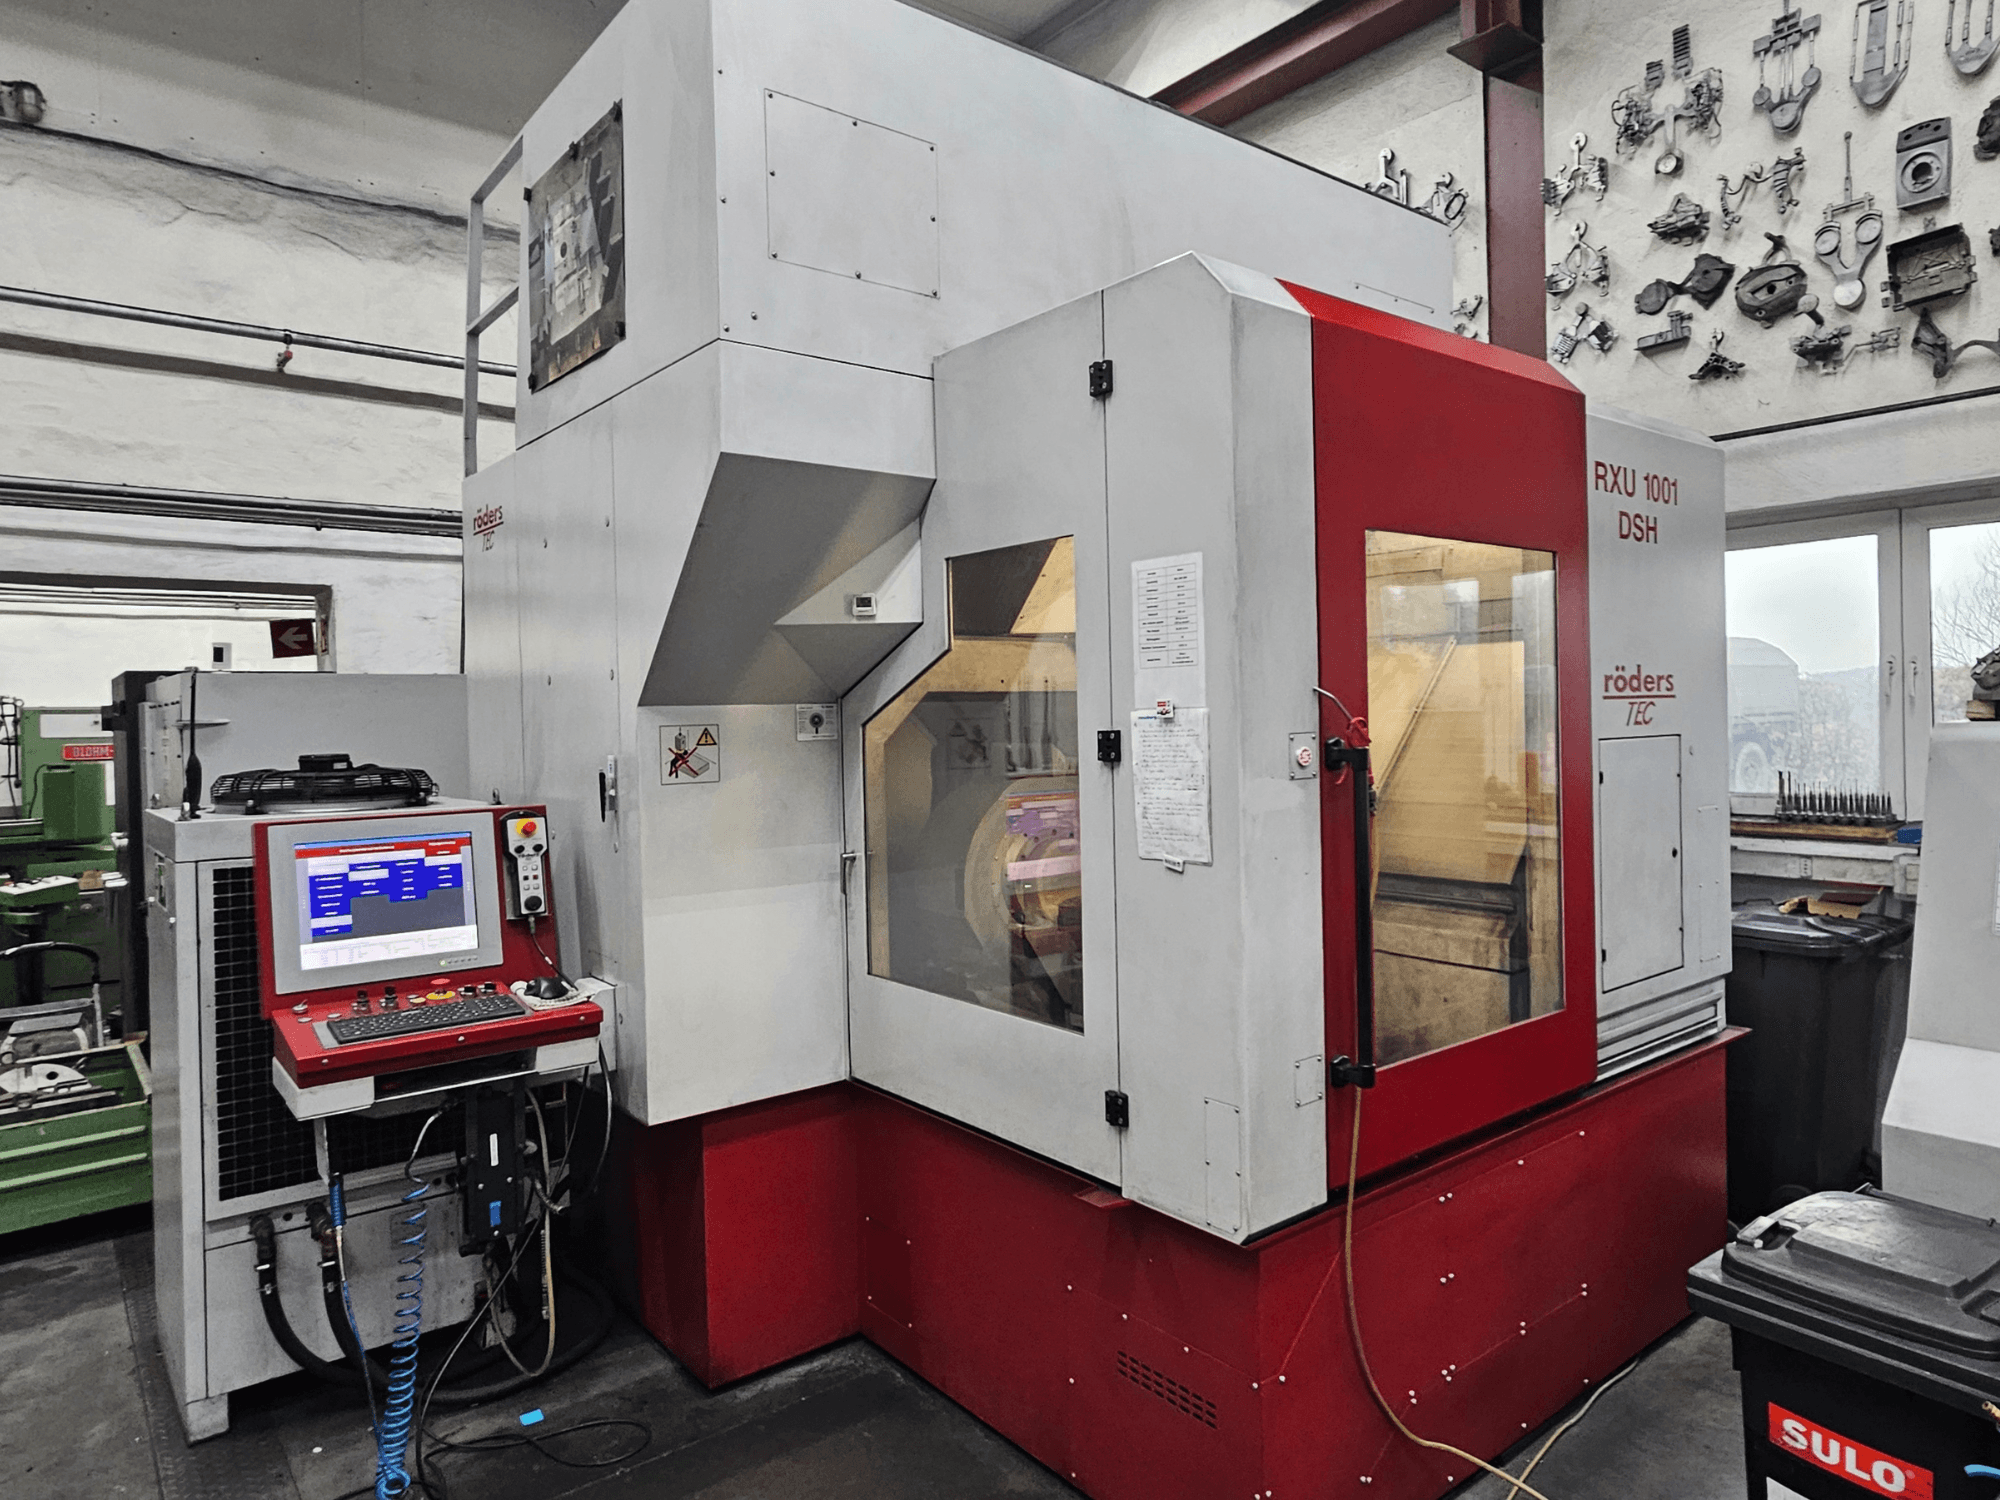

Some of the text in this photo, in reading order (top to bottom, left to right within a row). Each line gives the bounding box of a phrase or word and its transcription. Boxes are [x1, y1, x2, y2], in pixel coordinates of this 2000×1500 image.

[1593, 460, 1678, 506] RXU 1001
[473, 504, 502, 530] röders
[1618, 510, 1658, 545] DSH
[482, 530, 495, 552] TEC
[1603, 663, 1675, 693] röders
[1625, 701, 1657, 727] TEC
[1782, 1418, 1906, 1493] SULO
